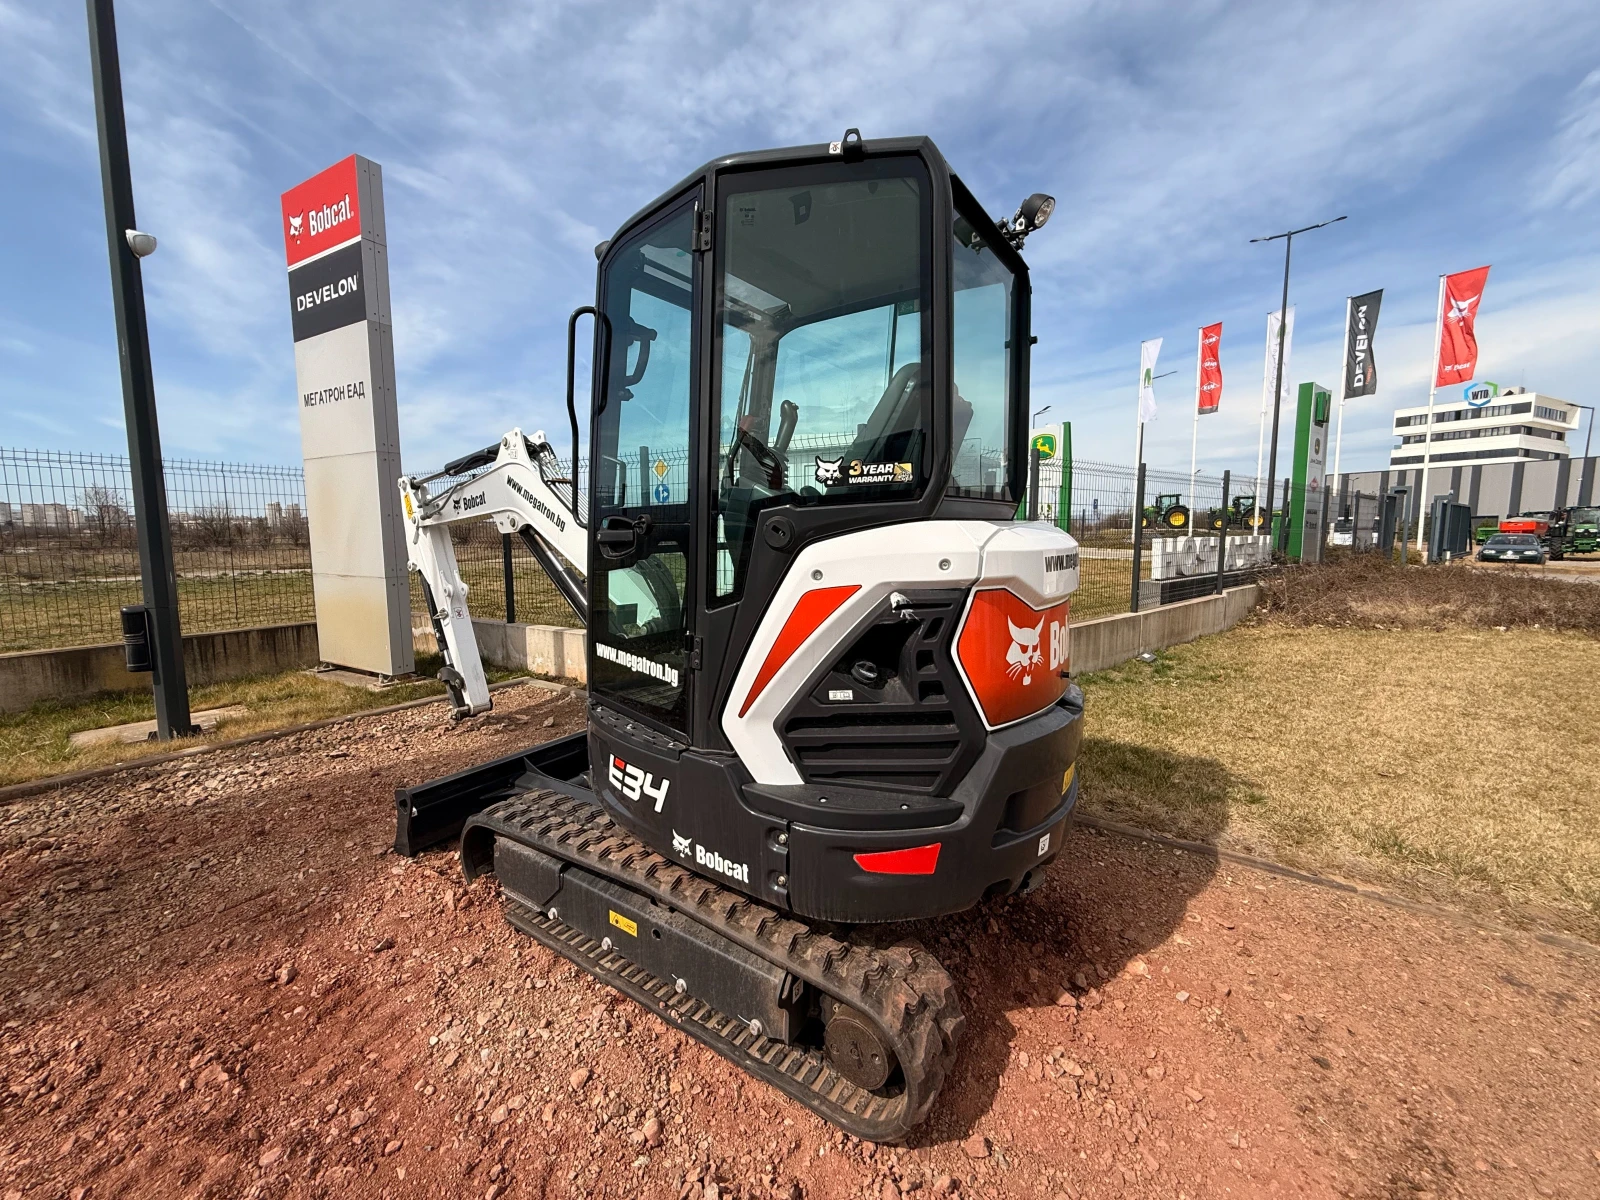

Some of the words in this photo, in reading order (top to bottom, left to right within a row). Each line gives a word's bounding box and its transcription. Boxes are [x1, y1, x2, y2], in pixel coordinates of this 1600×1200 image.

[309, 194, 351, 237] Bobcat
[296, 274, 358, 312] DEVELON
[303, 384, 345, 407] МЕГАТРОН
[347, 381, 365, 400] ЕАД
[848, 474, 894, 484] WARRANTY
[849, 459, 862, 476] 3
[862, 463, 894, 475] YEAR
[463, 491, 486, 511] Bobcat
[506, 474, 566, 532] www.megatron.bg
[596, 642, 679, 688] www.megatron.bg
[608, 754, 670, 813] E34
[696, 844, 749, 883] Bobcat
